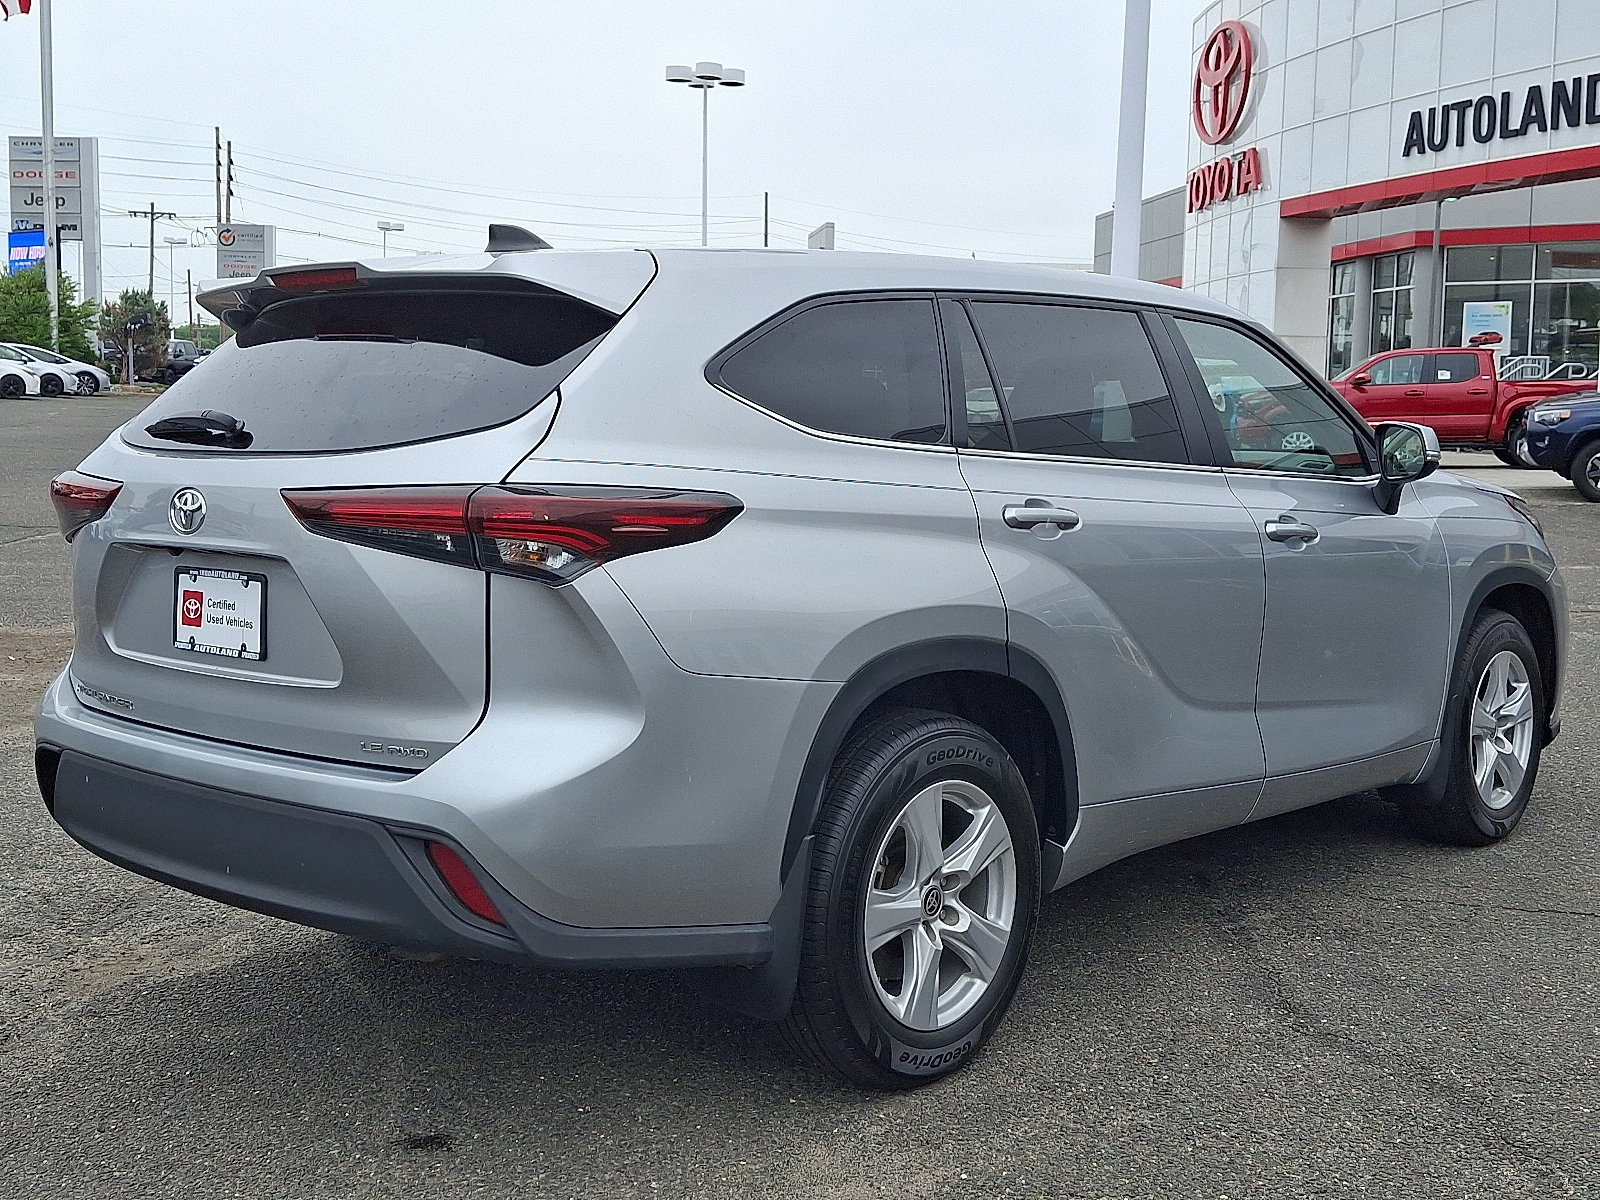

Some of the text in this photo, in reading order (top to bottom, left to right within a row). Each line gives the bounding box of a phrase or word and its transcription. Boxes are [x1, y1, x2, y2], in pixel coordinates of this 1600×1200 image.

[1186, 148, 1261, 213] TOYOTA
[23, 192, 66, 209] Jep
[207, 598, 236, 611] Certified
[206, 613, 254, 629] Used Vehicles
[194, 644, 240, 657] AUTOLAND
[926, 745, 994, 767] GeoDrive
[899, 1040, 972, 1069] GeoDrive
